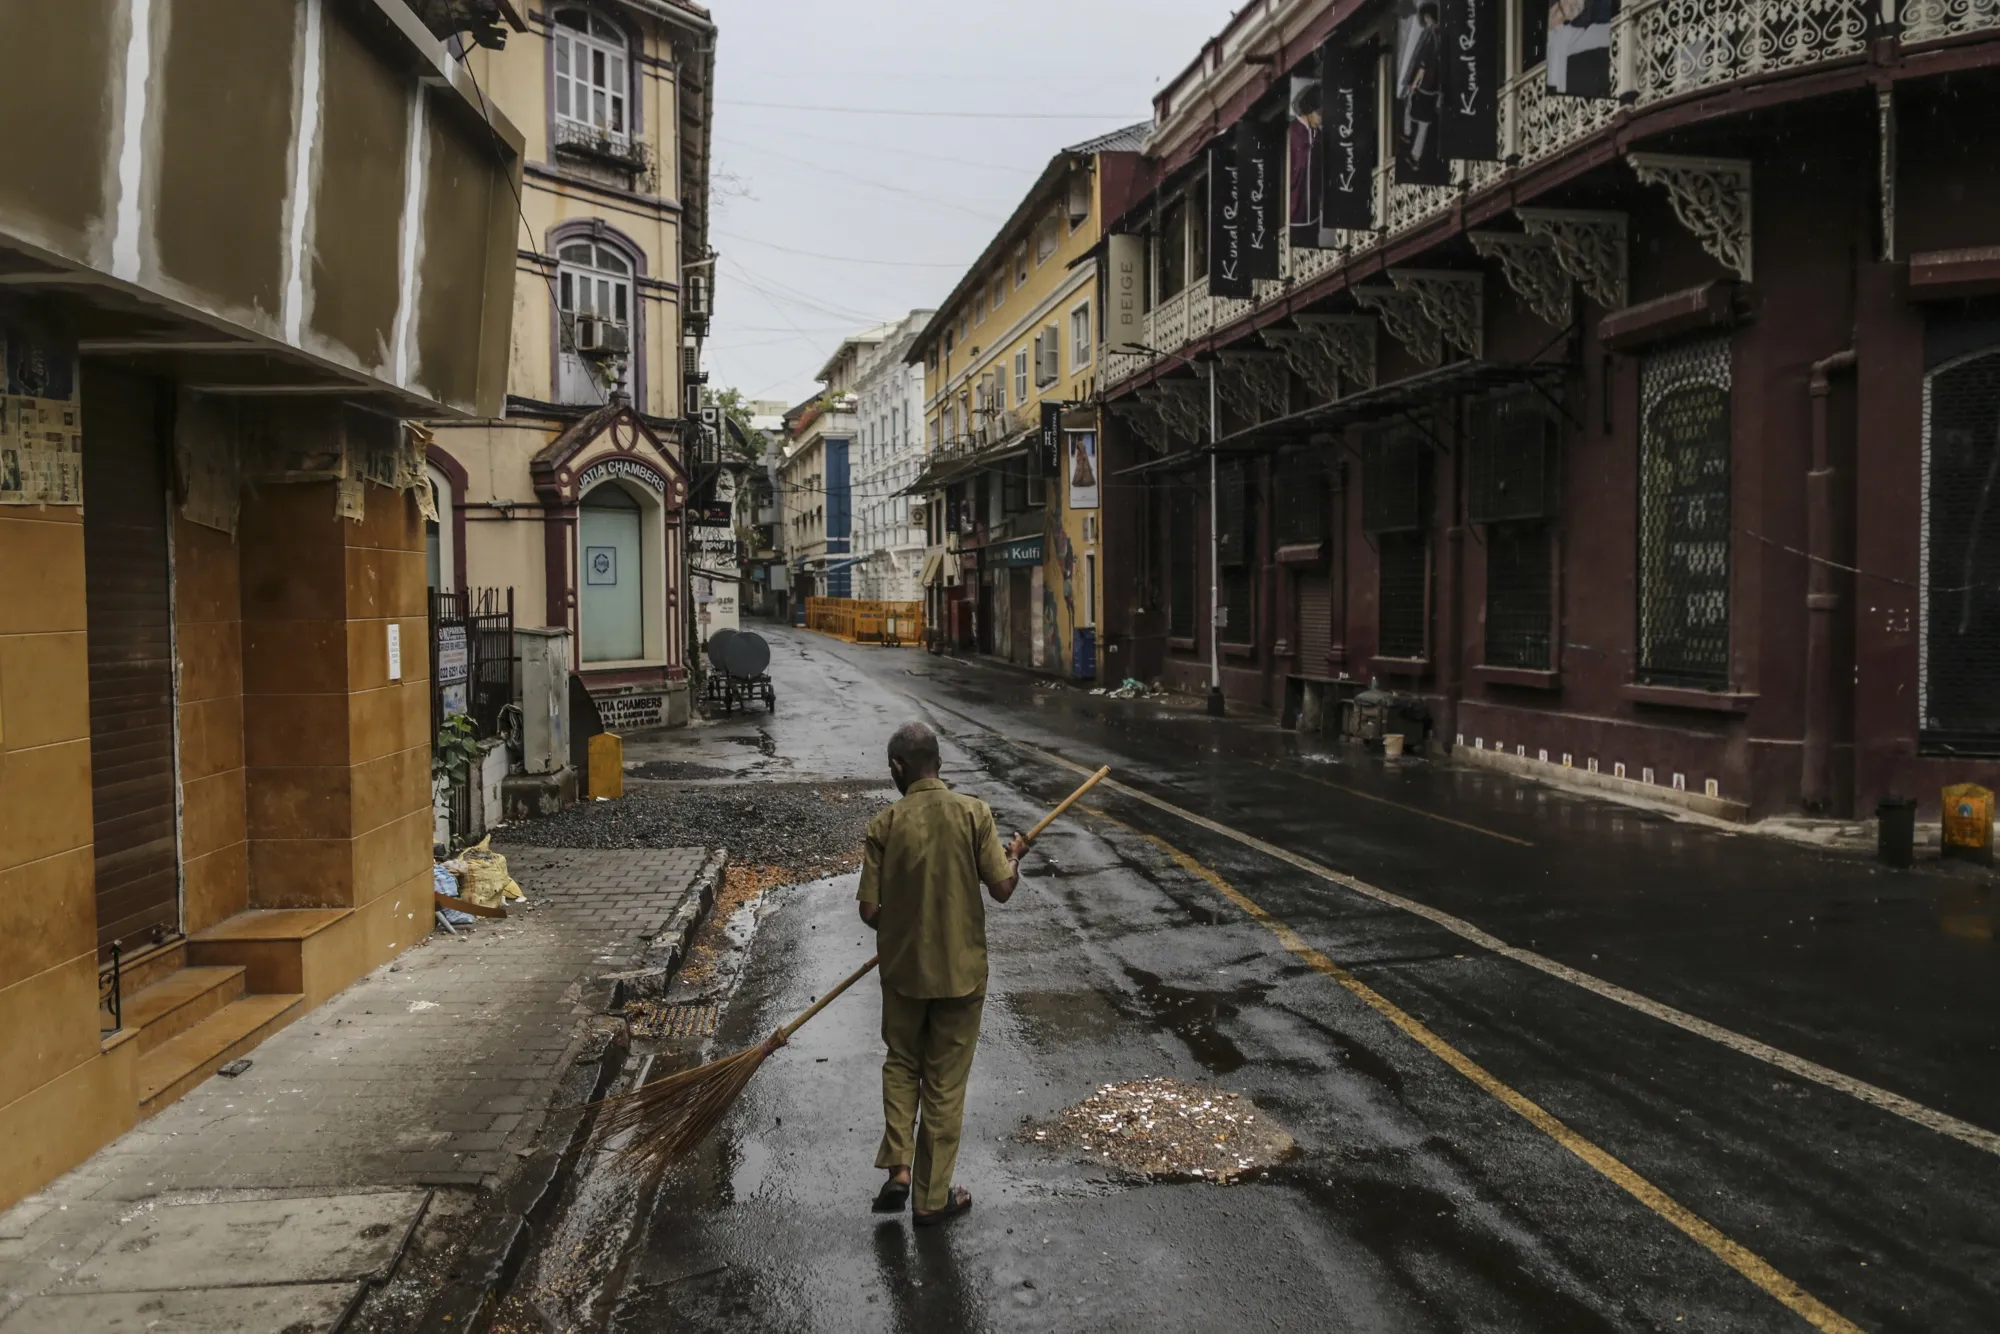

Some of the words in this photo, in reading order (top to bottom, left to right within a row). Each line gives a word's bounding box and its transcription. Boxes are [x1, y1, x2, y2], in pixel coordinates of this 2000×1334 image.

[1459, 56, 1479, 116] Kunal
[1339, 142, 1356, 192] Kunal
[1251, 205, 1266, 250] Kunal
[1222, 225, 1238, 281] Kunal
[1120, 261, 1133, 325] BEIGE
[578, 464, 605, 489] JATIA
[607, 461, 665, 492] CHAMBERS
[1012, 547, 1040, 559] Kulfi
[597, 700, 615, 713] ATIA
[617, 697, 662, 711] CHAMBERS
